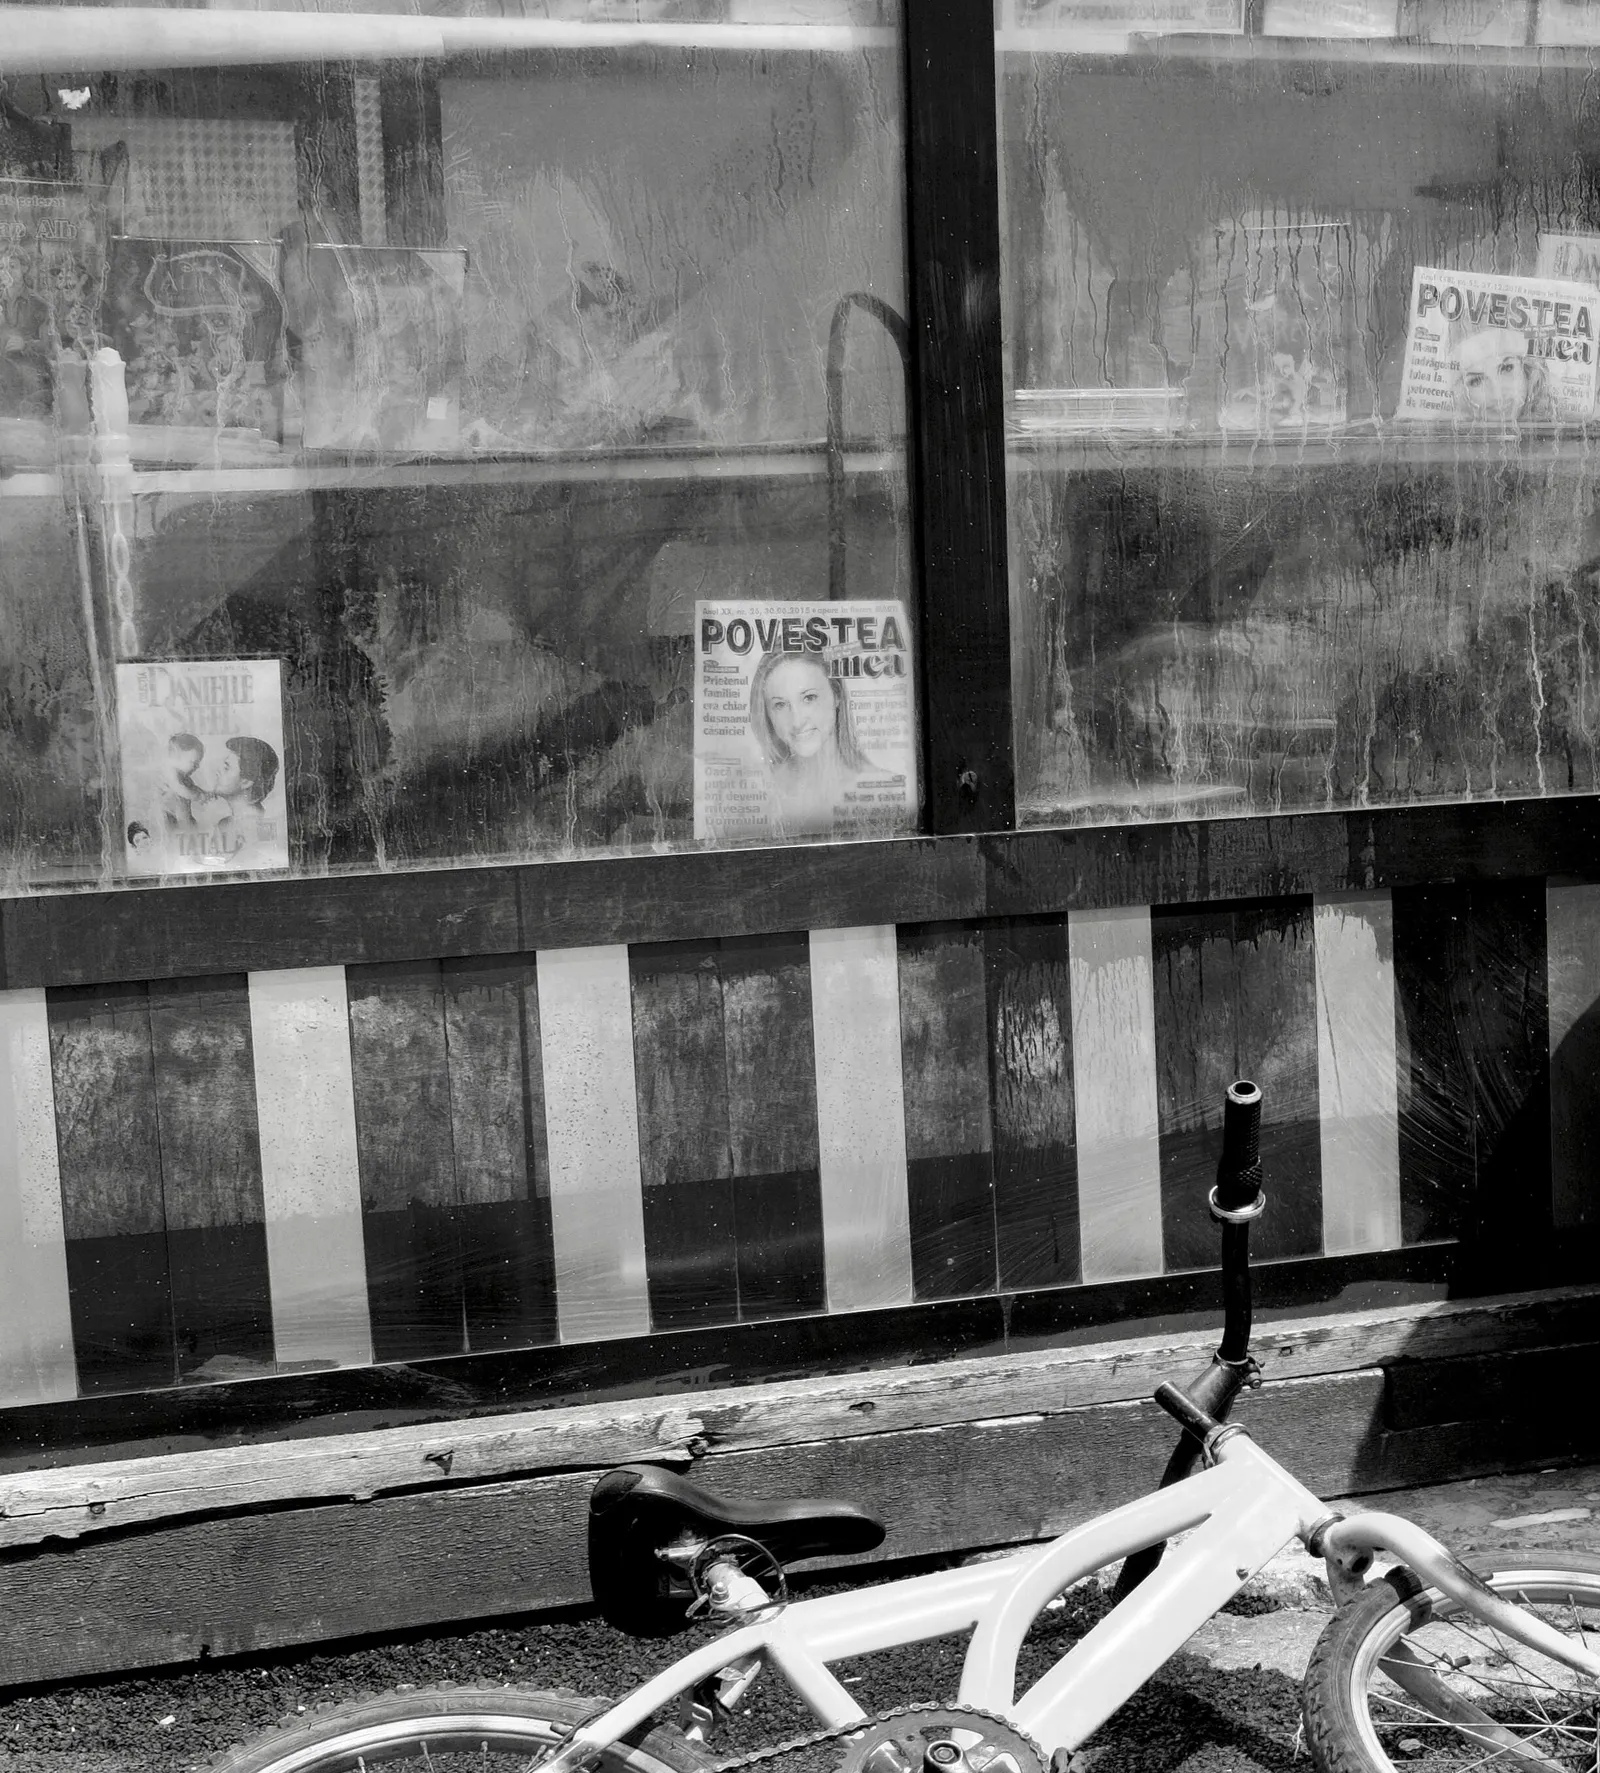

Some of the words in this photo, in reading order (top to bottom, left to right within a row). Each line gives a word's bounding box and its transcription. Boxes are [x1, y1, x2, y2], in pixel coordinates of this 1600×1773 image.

[1417, 283, 1594, 341] POVESTEA
[1525, 338, 1592, 365] mea
[701, 616, 907, 655] POVESTEA
[828, 654, 907, 679] mea
[722, 701, 748, 711] chiar
